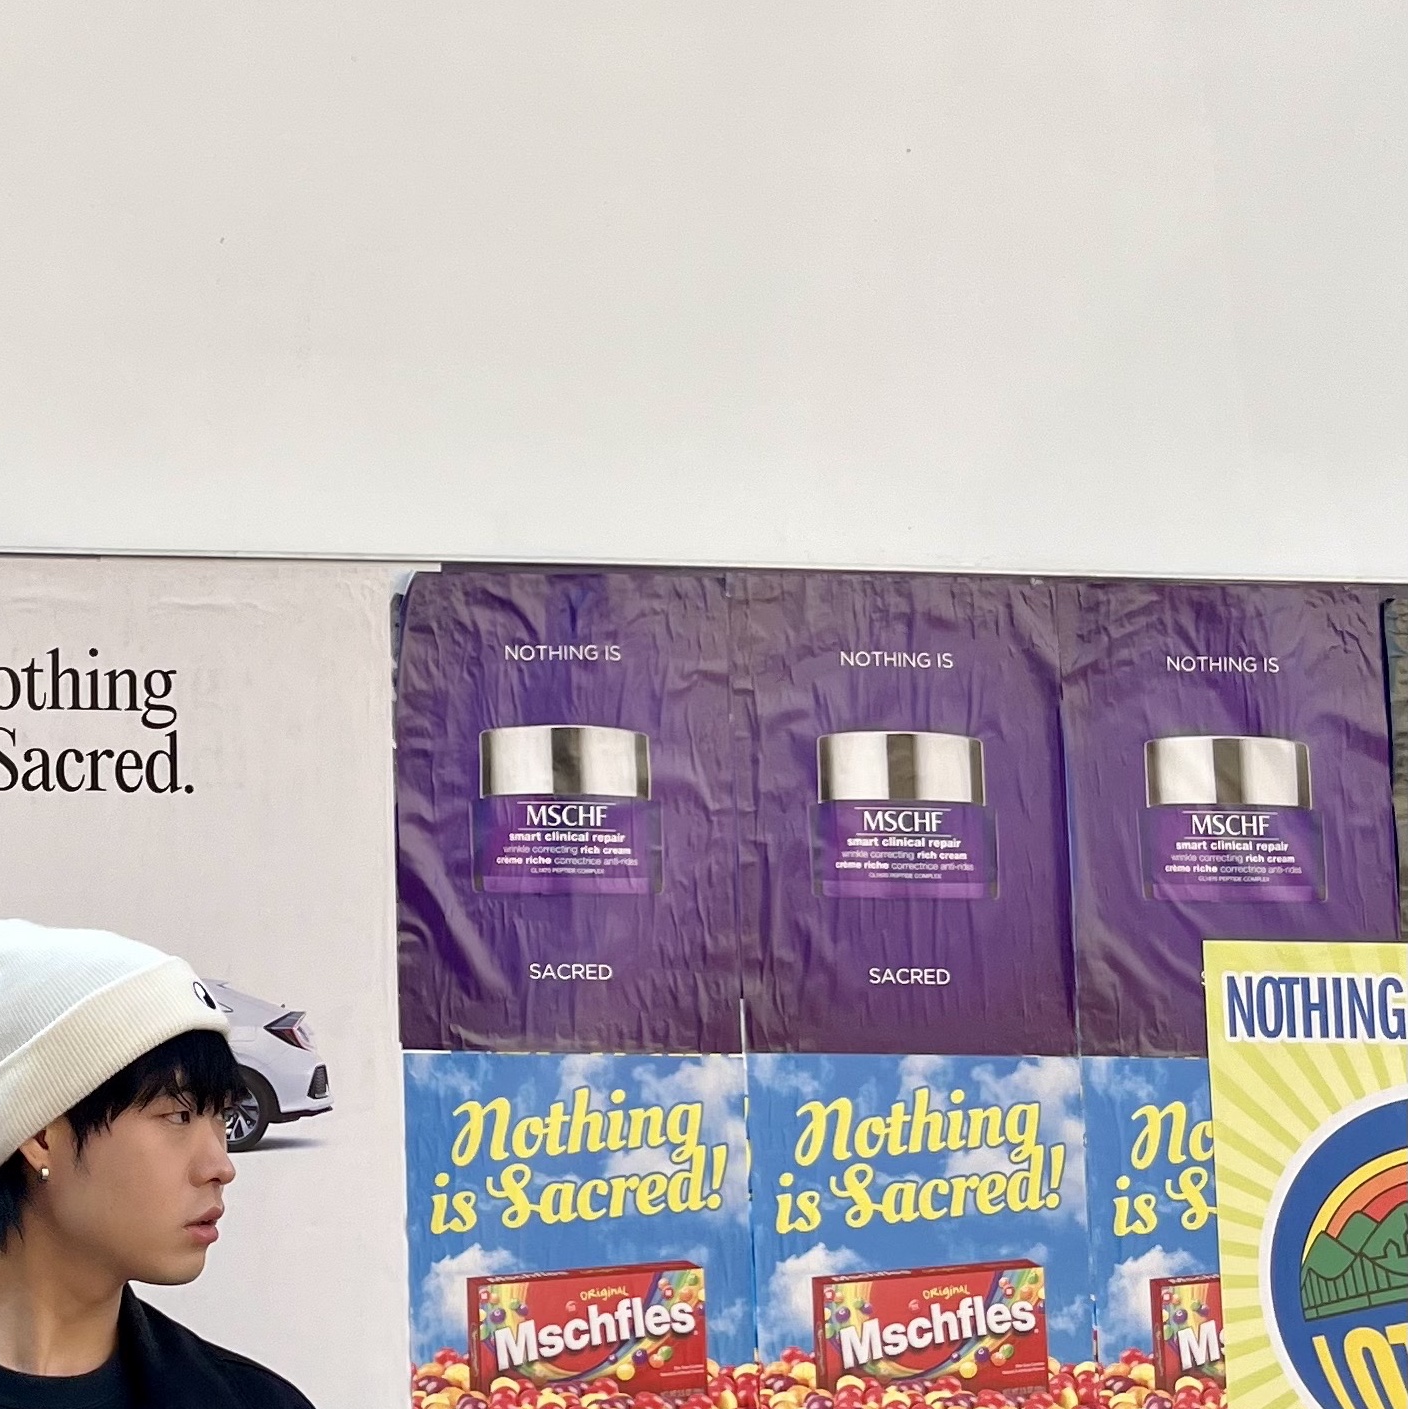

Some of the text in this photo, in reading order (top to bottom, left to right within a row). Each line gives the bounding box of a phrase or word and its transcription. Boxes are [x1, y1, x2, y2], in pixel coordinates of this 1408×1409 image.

[504, 643, 621, 663] NOTHING IS
[840, 651, 954, 669] NOTHING IS
[1166, 656, 1280, 673] NOTHING IS
[526, 804, 609, 827] MSCHF
[863, 811, 943, 832] MSCHF
[1192, 815, 1271, 836] MSCHF
[509, 831, 626, 844] smart clinical repair
[847, 837, 961, 849] smart clinical repair
[1176, 840, 1289, 853] smart clinical repair
[580, 845, 600, 854] rich
[603, 847, 631, 855] cream
[917, 850, 937, 860] rich
[939, 852, 967, 860] cream
[1245, 854, 1265, 863] rich
[528, 963, 613, 981] SACRED
[868, 968, 950, 985] SACRED
[1226, 976, 1407, 1039] NOTHING
[452, 1086, 702, 1168] Nothing
[795, 1086, 1041, 1166] Nothing
[430, 1144, 727, 1235] is Sacred!
[776, 1145, 1065, 1234] is Sacred!
[1113, 1175, 1157, 1236] is
[494, 1297, 696, 1372] Mschfles
[839, 1296, 1036, 1370] Mschfles
